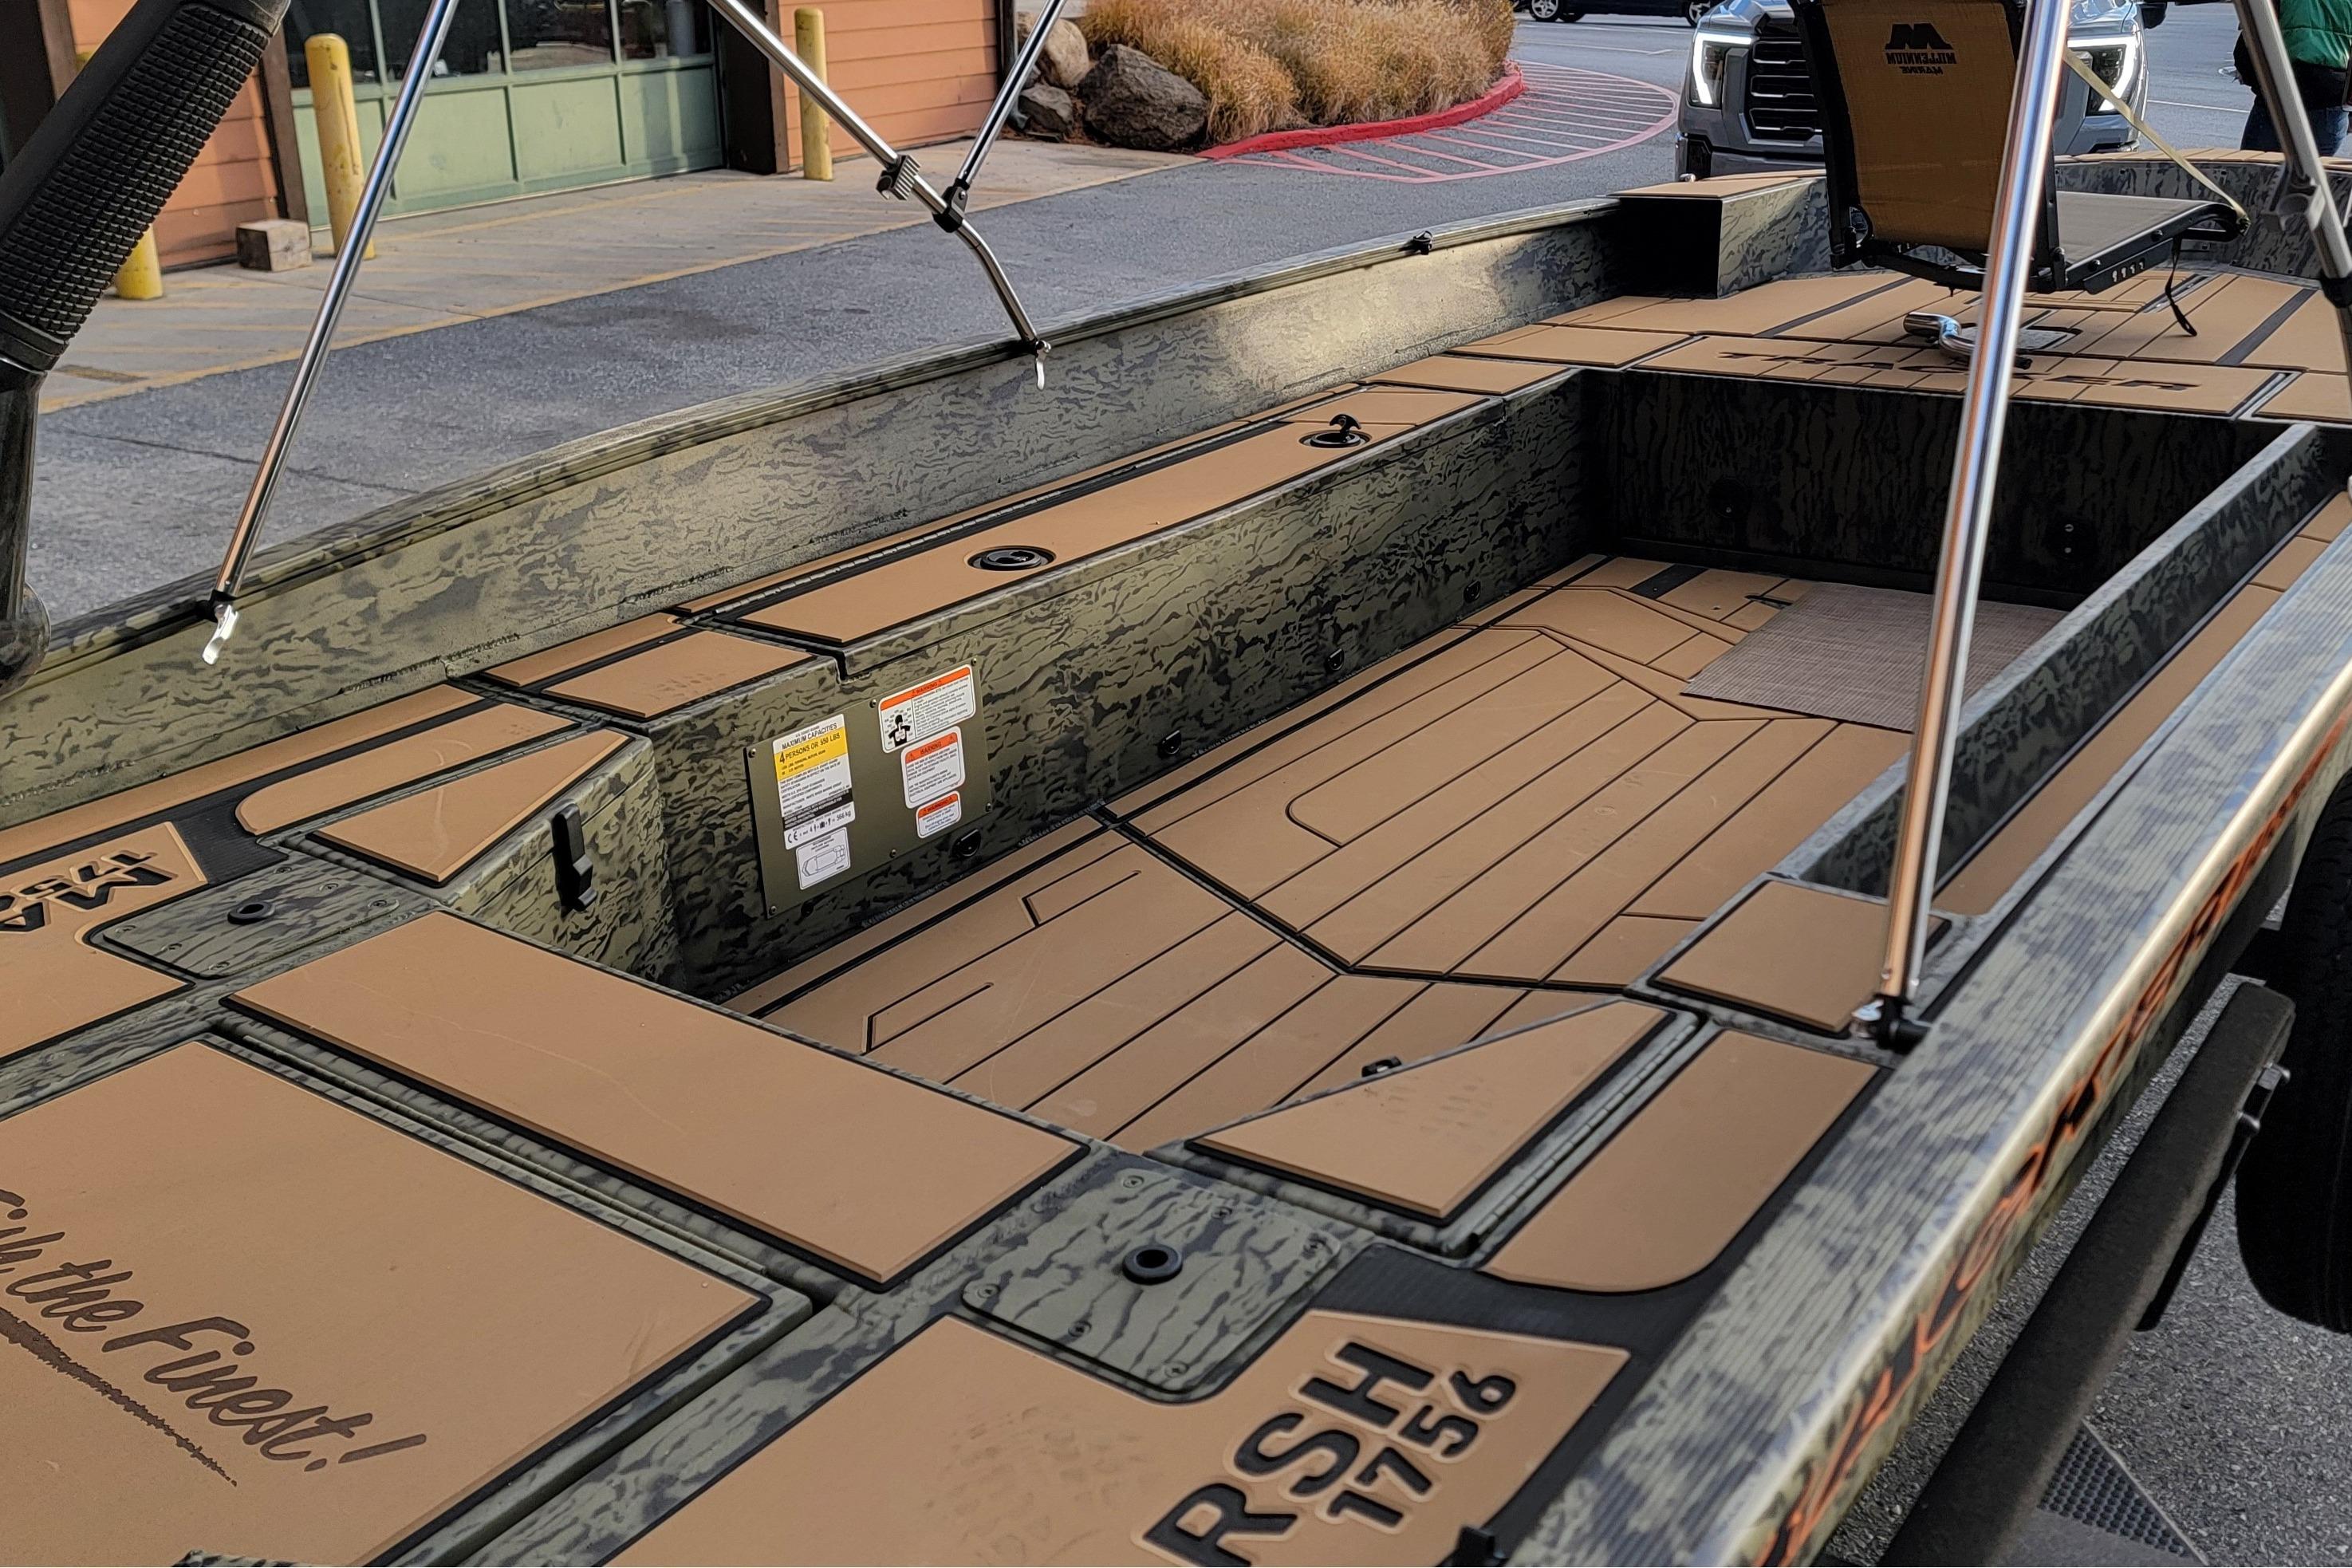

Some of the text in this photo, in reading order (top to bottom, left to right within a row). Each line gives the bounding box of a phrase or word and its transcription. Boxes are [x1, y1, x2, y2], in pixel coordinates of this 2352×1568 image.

[916, 682, 939, 693] WARNING
[782, 723, 837, 750] MAXIMUM CAPACITIES
[920, 741, 942, 754] WARNING
[779, 751, 786, 764] 4
[786, 745, 810, 759] PERSONS
[810, 741, 819, 750] OR
[6, 1259, 427, 1472] the Finest!
[1142, 1341, 1435, 1568] RSH
[1326, 1369, 1517, 1529] 1756
